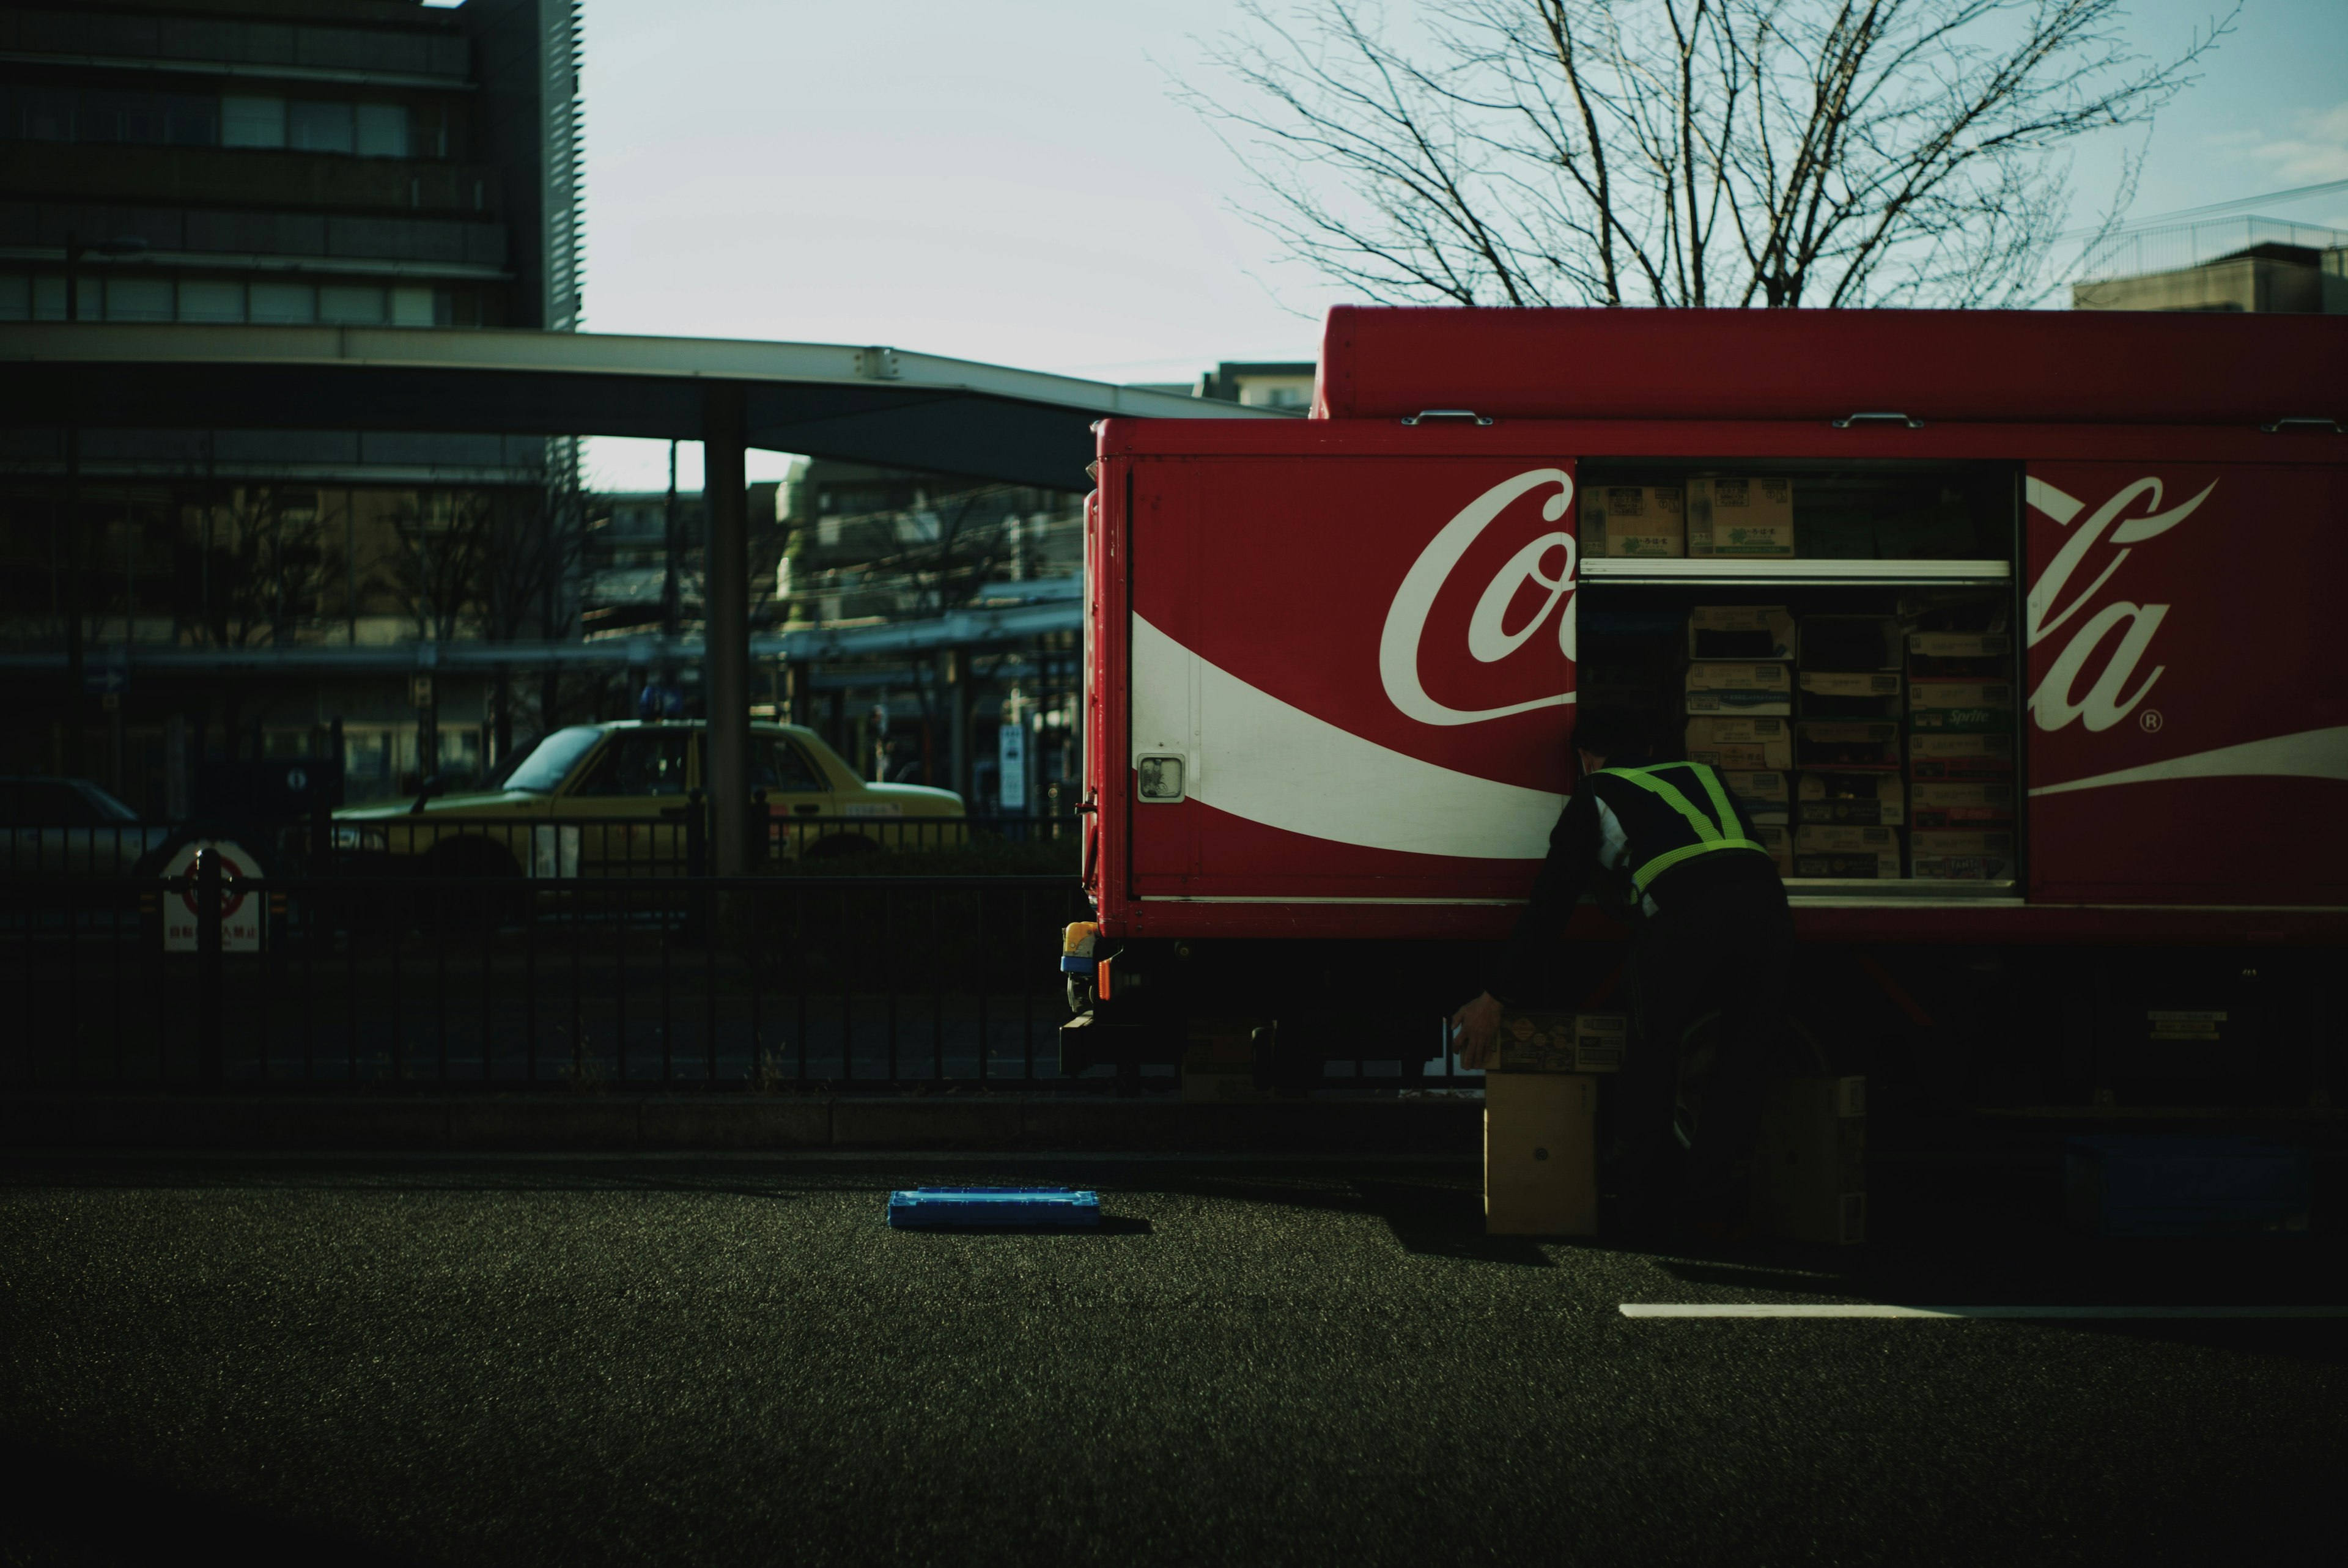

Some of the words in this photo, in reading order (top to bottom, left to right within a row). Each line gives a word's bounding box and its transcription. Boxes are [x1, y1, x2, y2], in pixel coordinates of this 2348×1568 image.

[1948, 710, 1989, 724] Sprite
[169, 926, 256, 940] 自転入禁止
